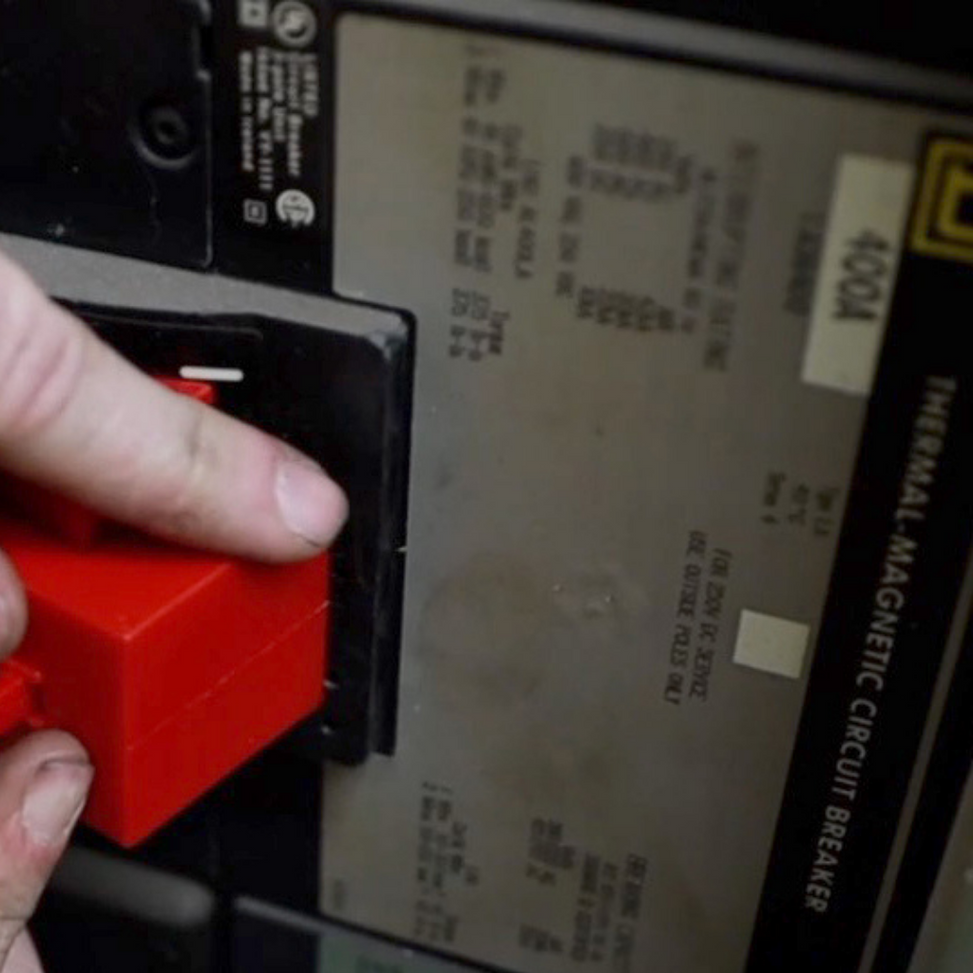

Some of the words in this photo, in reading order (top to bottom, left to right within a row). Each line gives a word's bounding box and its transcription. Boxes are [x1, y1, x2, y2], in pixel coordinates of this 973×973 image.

[833, 231, 891, 323] 400A
[855, 375, 956, 693] THERMAL-MAGNETIC
[670, 623, 691, 668] POLES
[830, 698, 878, 800] CIRCUIT
[803, 804, 852, 914] BREAKER
